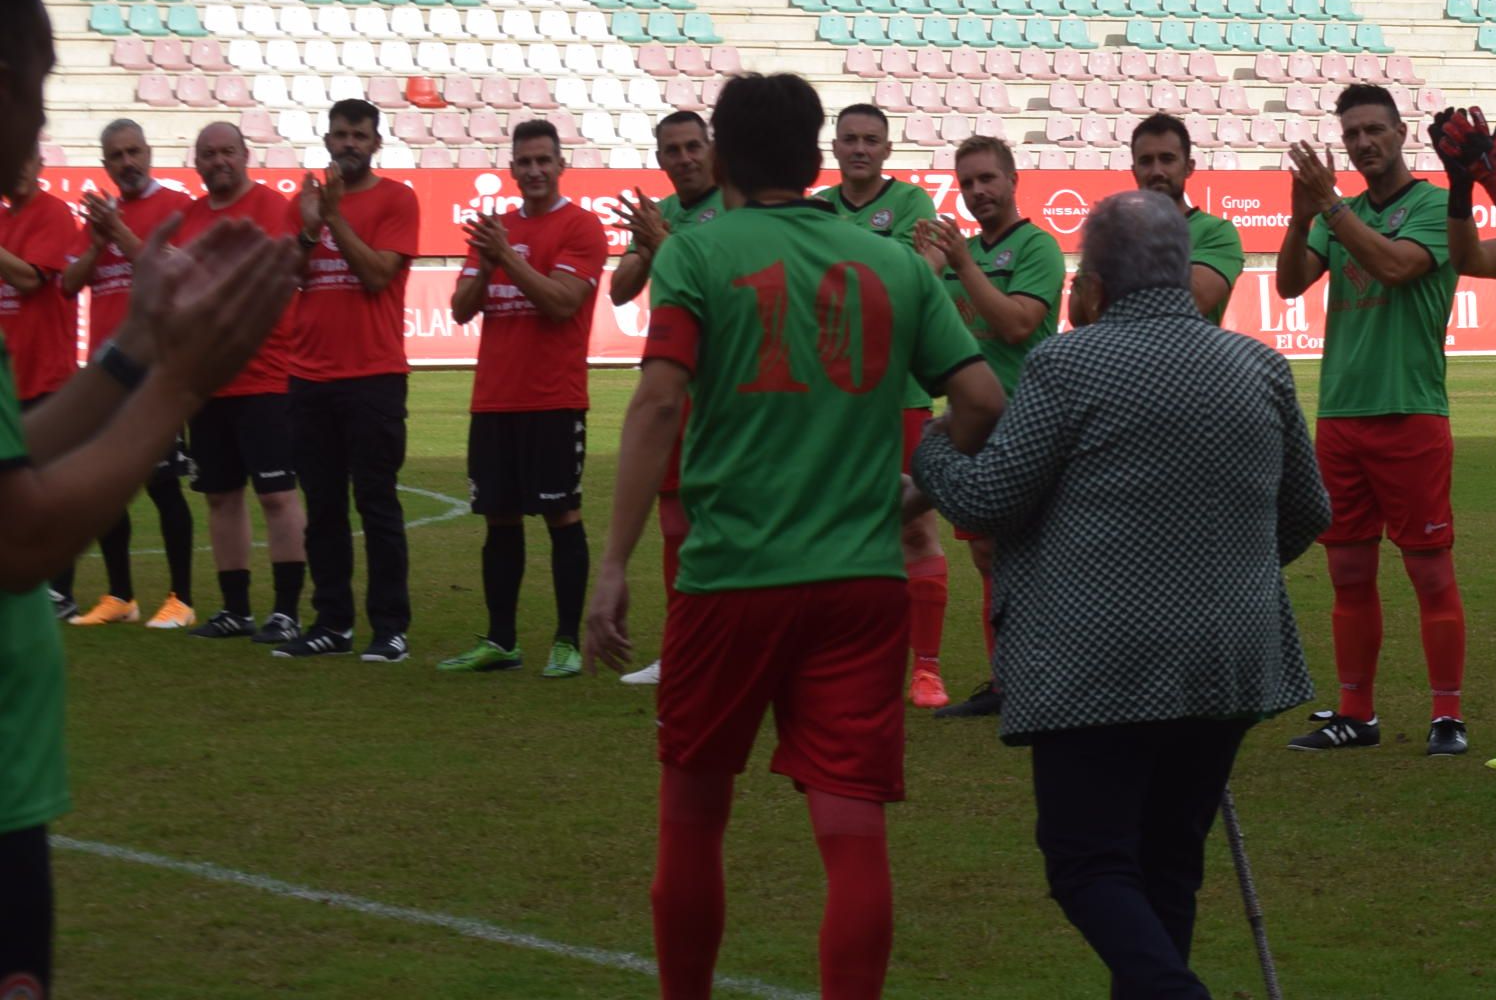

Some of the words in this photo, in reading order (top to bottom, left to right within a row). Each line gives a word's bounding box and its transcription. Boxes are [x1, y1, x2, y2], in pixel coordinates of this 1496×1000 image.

[1222, 195, 1260, 210] Grupo
[1043, 207, 1090, 215] NISSAN
[1258, 274, 1310, 332] La
[731, 259, 894, 396] 10
[1276, 335, 1293, 349] El
